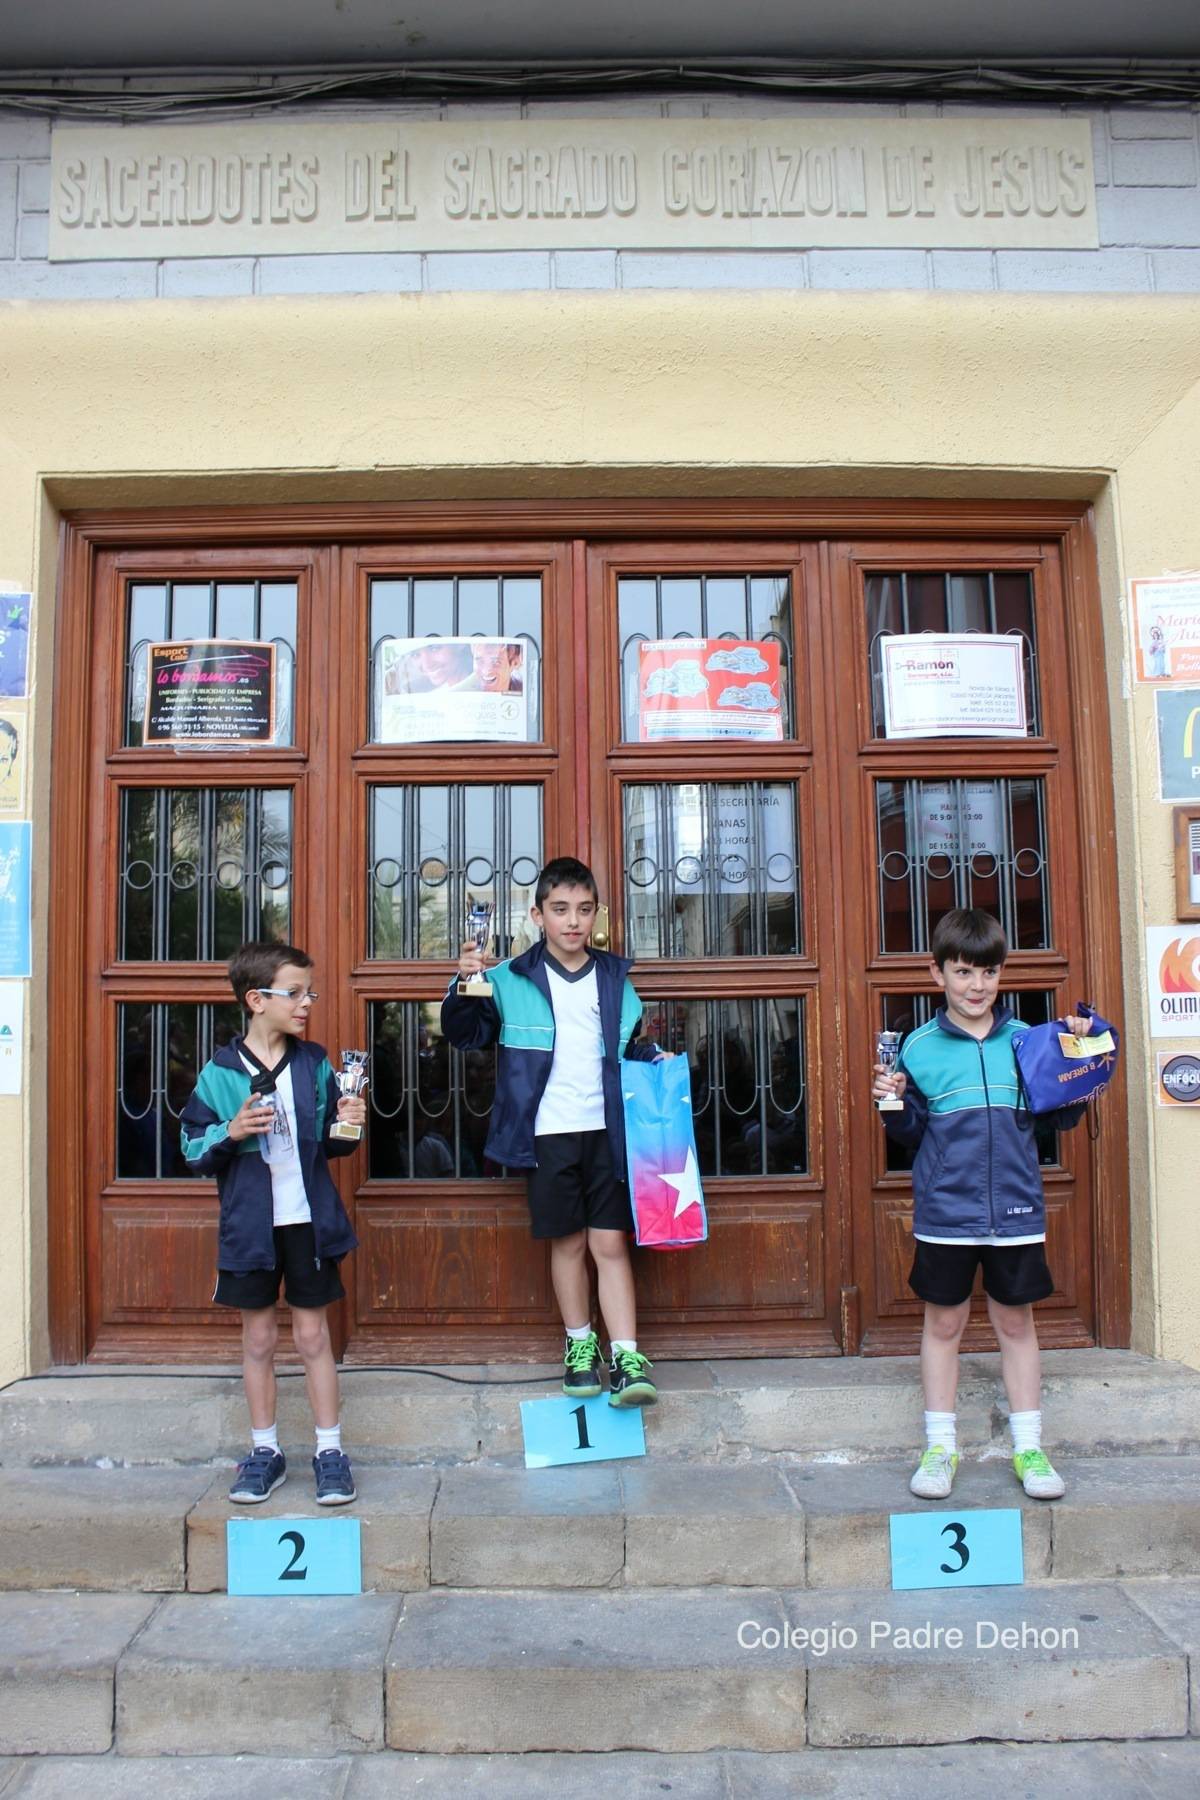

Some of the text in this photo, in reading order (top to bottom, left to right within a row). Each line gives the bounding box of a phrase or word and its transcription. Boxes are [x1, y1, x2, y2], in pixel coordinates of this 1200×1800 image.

[59, 145, 1086, 229] SACERDOTES DEL SAGRADO CORAZON DE JESUS
[569, 1404, 595, 1451] 1
[277, 1530, 308, 1581] 2
[940, 1522, 970, 1574] 3
